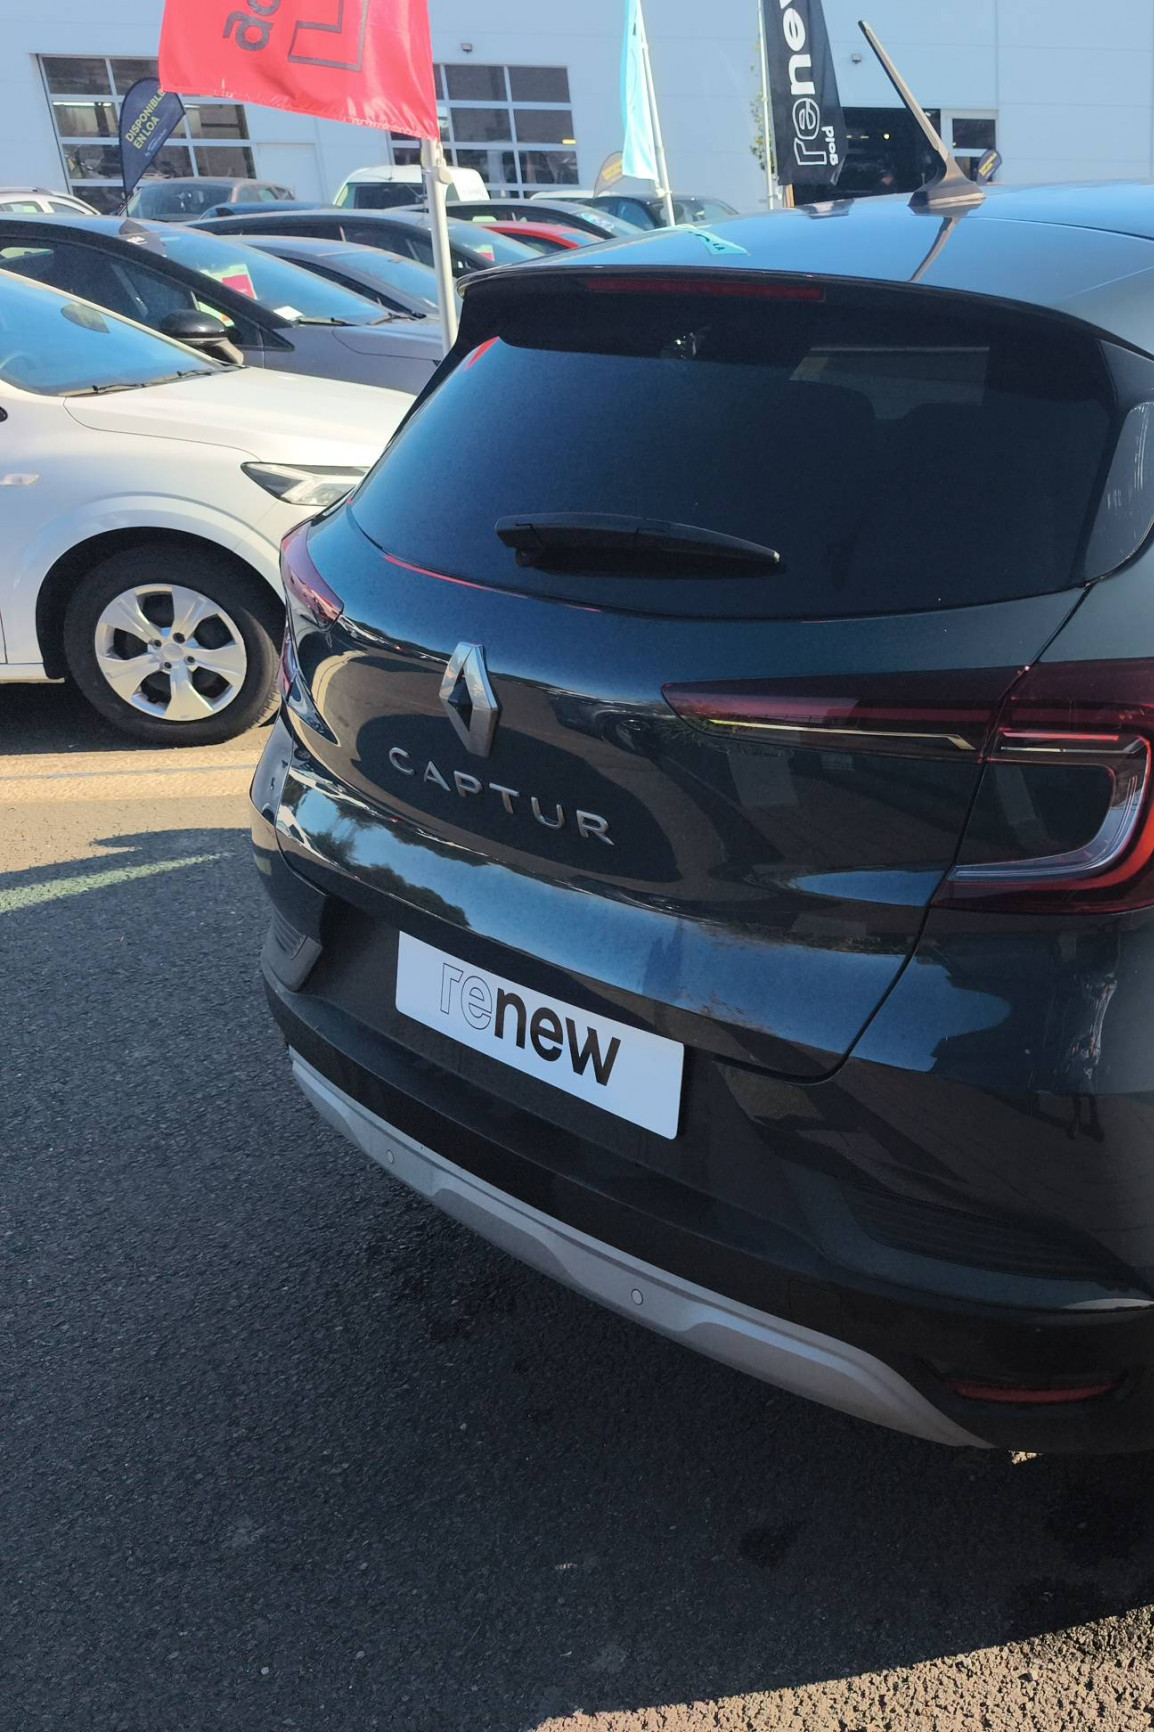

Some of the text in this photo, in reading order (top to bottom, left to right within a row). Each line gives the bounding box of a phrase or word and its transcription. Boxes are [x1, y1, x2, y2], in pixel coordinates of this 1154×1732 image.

[779, 0, 827, 165] rene
[133, 134, 147, 149] EN
[142, 117, 160, 136] LOA
[822, 126, 838, 165] gold
[388, 746, 616, 845] CAPTUR
[440, 962, 621, 1086] renew
